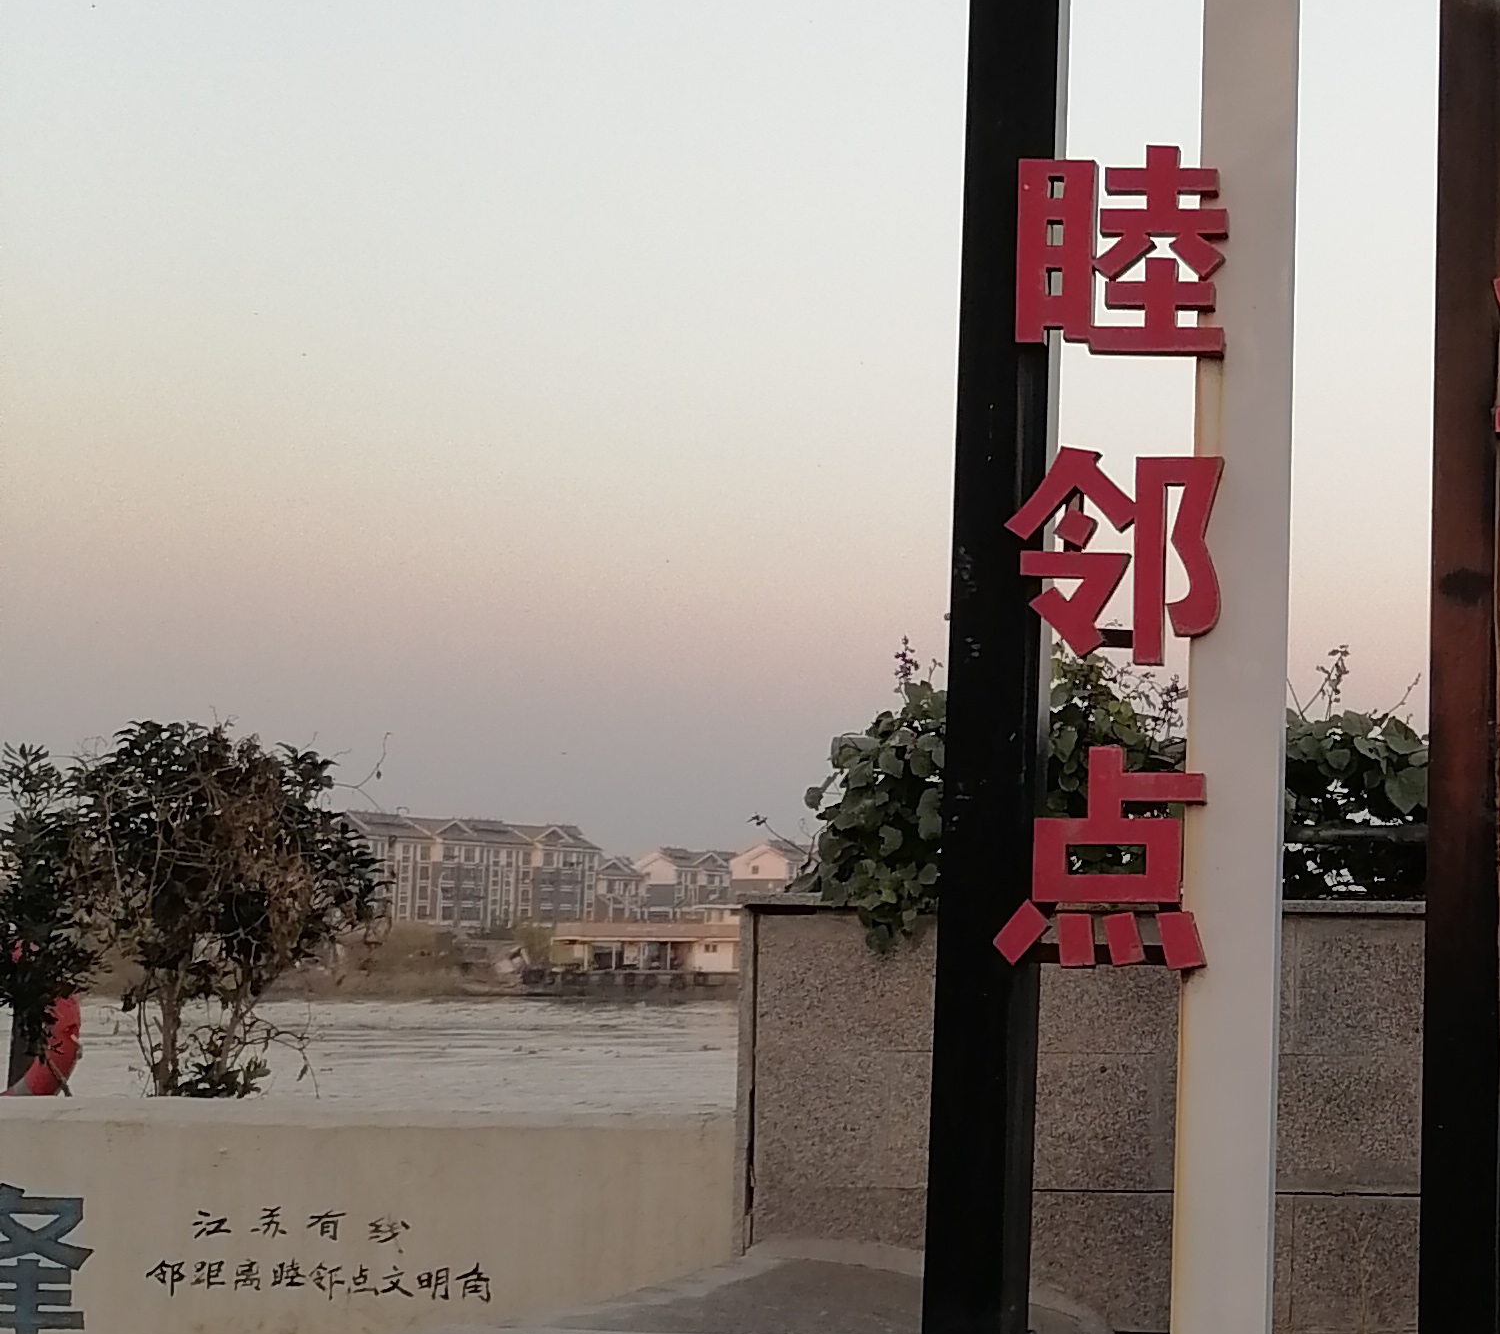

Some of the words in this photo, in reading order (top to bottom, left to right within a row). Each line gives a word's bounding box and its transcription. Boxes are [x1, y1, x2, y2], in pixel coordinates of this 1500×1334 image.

[993, 144, 1229, 970] 睦邻点
[192, 1206, 411, 1253] 江苏有线
